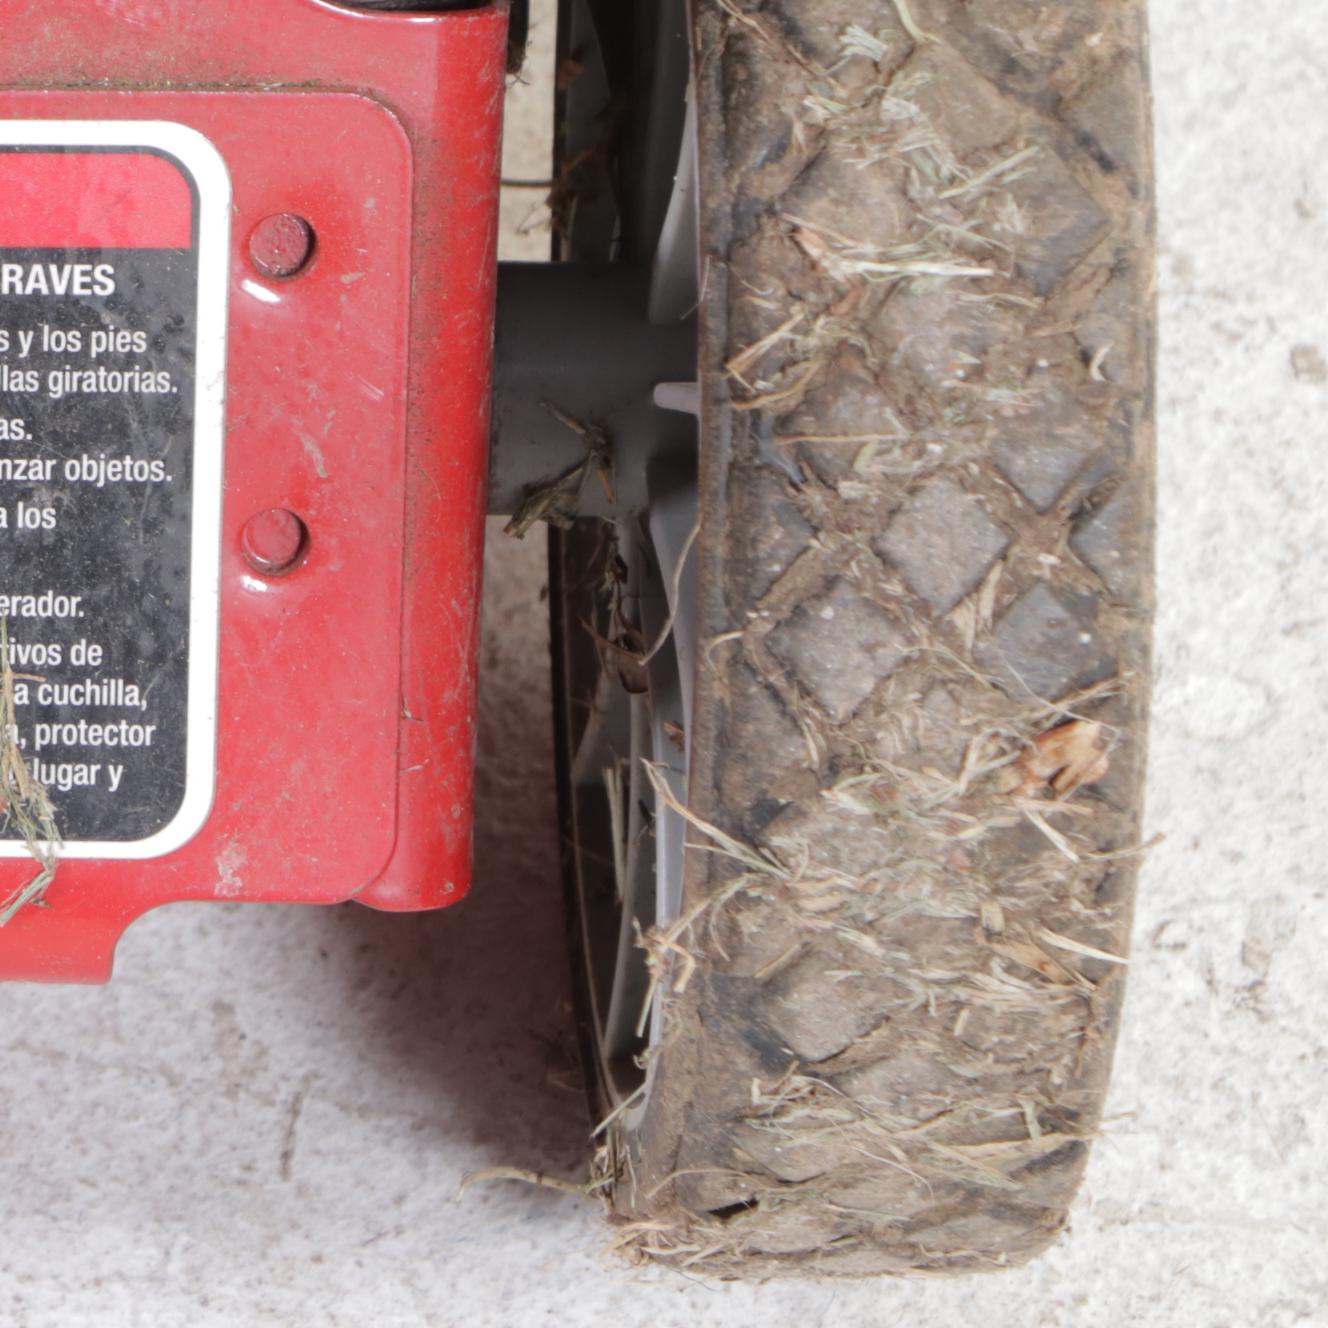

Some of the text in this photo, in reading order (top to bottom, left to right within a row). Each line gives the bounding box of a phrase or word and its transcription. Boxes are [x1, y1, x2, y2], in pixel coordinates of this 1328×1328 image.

[18, 330, 34, 359] y
[42, 324, 82, 353] los
[90, 323, 148, 359] pies
[48, 364, 178, 399] giratorias.
[64, 453, 172, 487] objetos.
[17, 501, 57, 530] los
[70, 639, 103, 666] de
[37, 679, 147, 711] cuchilla,
[35, 719, 157, 751] protector
[32, 757, 102, 793] lugar
[108, 764, 124, 792] y
